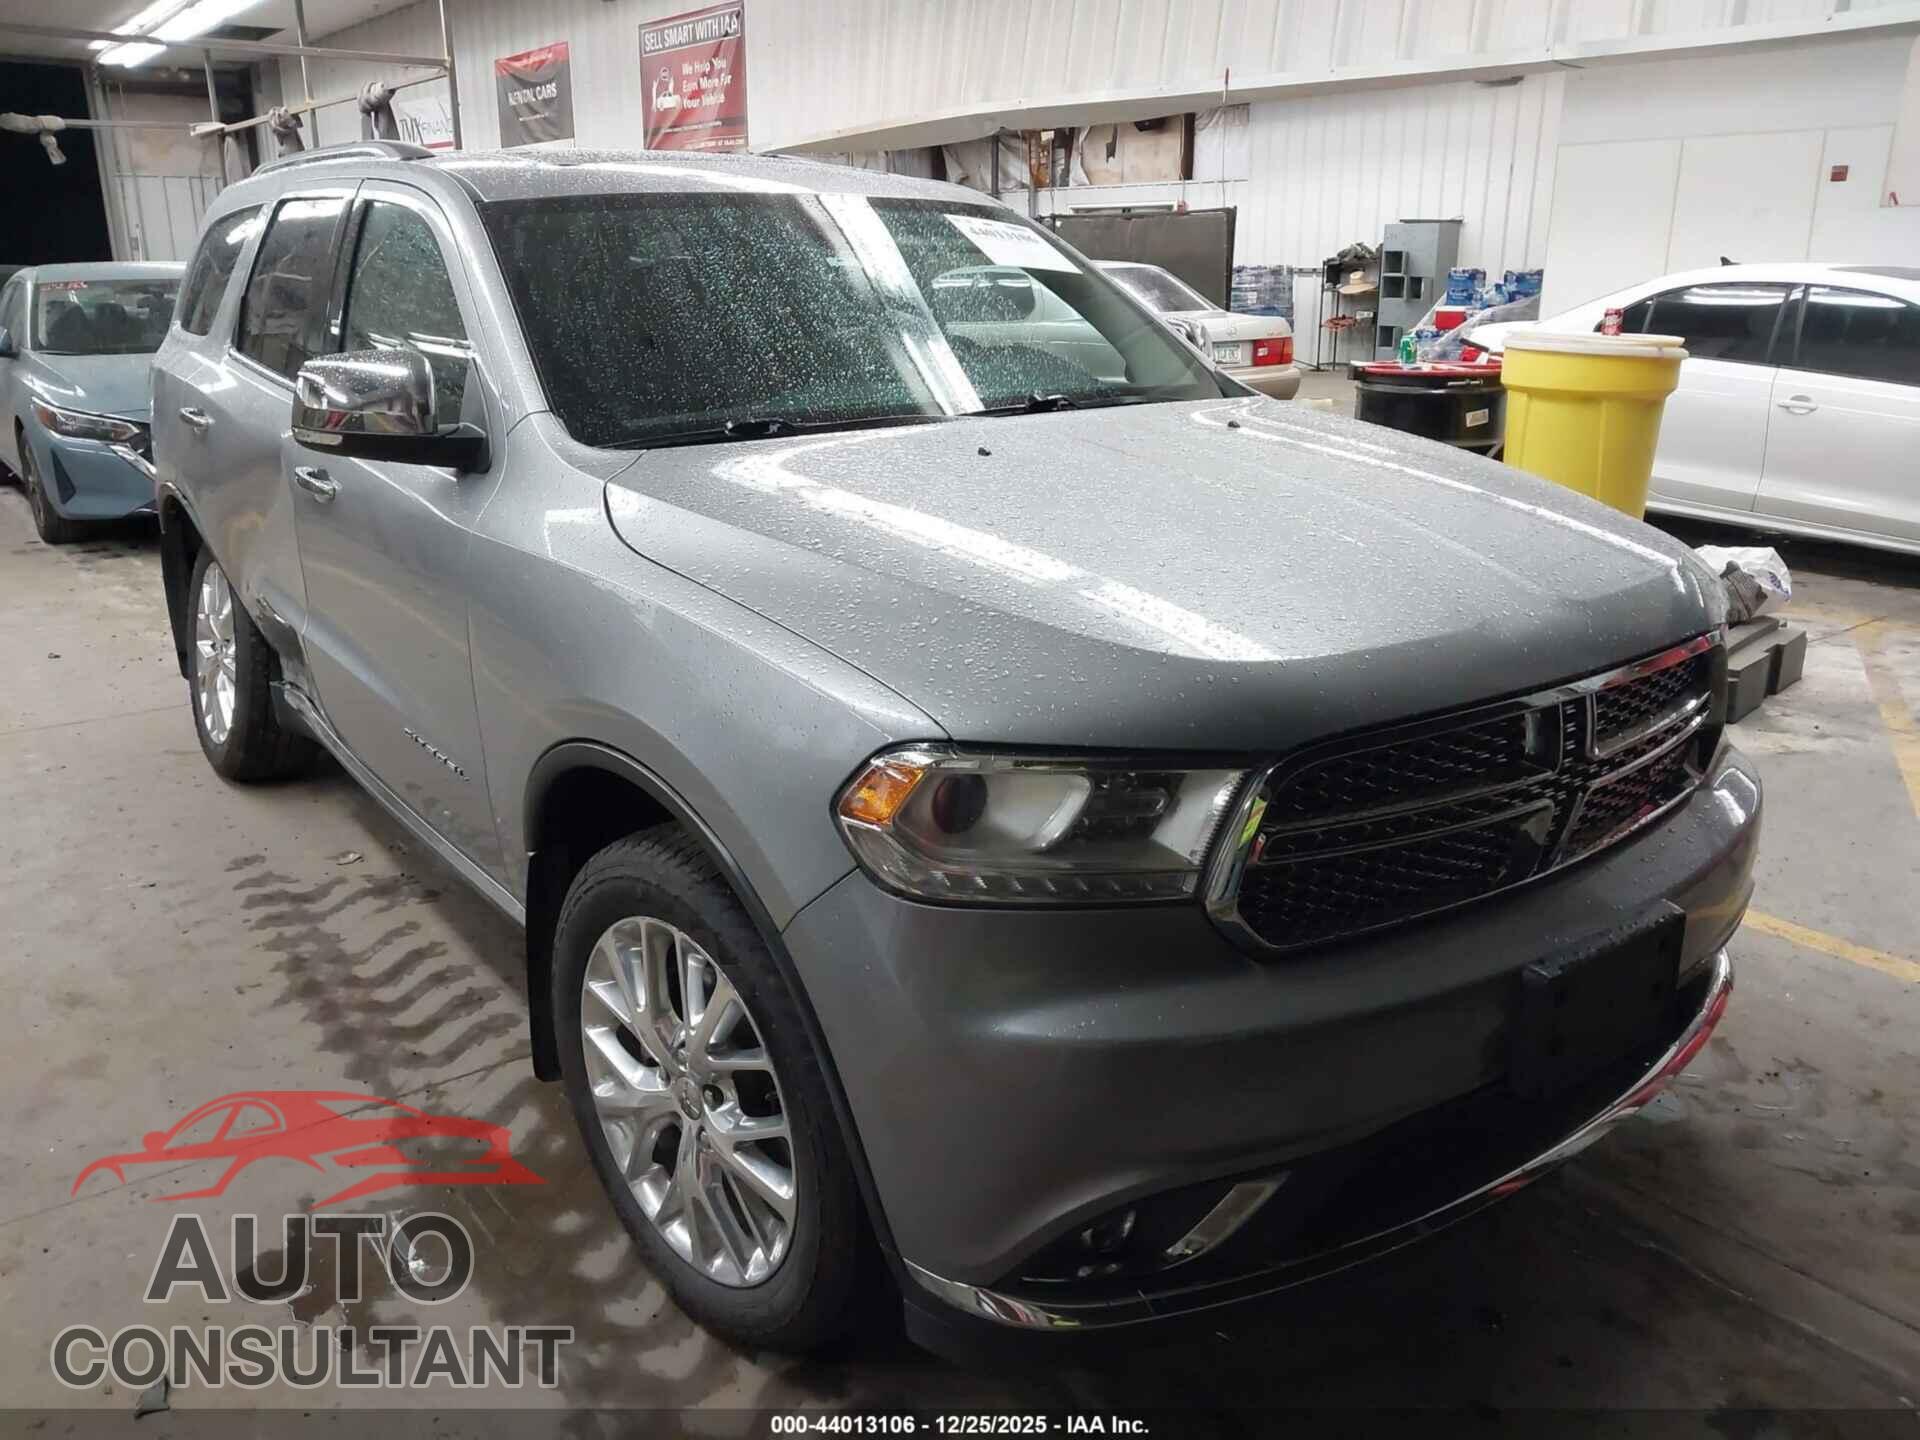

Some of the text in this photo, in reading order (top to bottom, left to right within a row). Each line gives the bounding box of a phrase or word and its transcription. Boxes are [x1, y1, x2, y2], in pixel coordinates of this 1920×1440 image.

[644, 32, 663, 52] SELL
[664, 24, 694, 47] SMART
[694, 18, 719, 41] WITH
[536, 82, 558, 100] CARS
